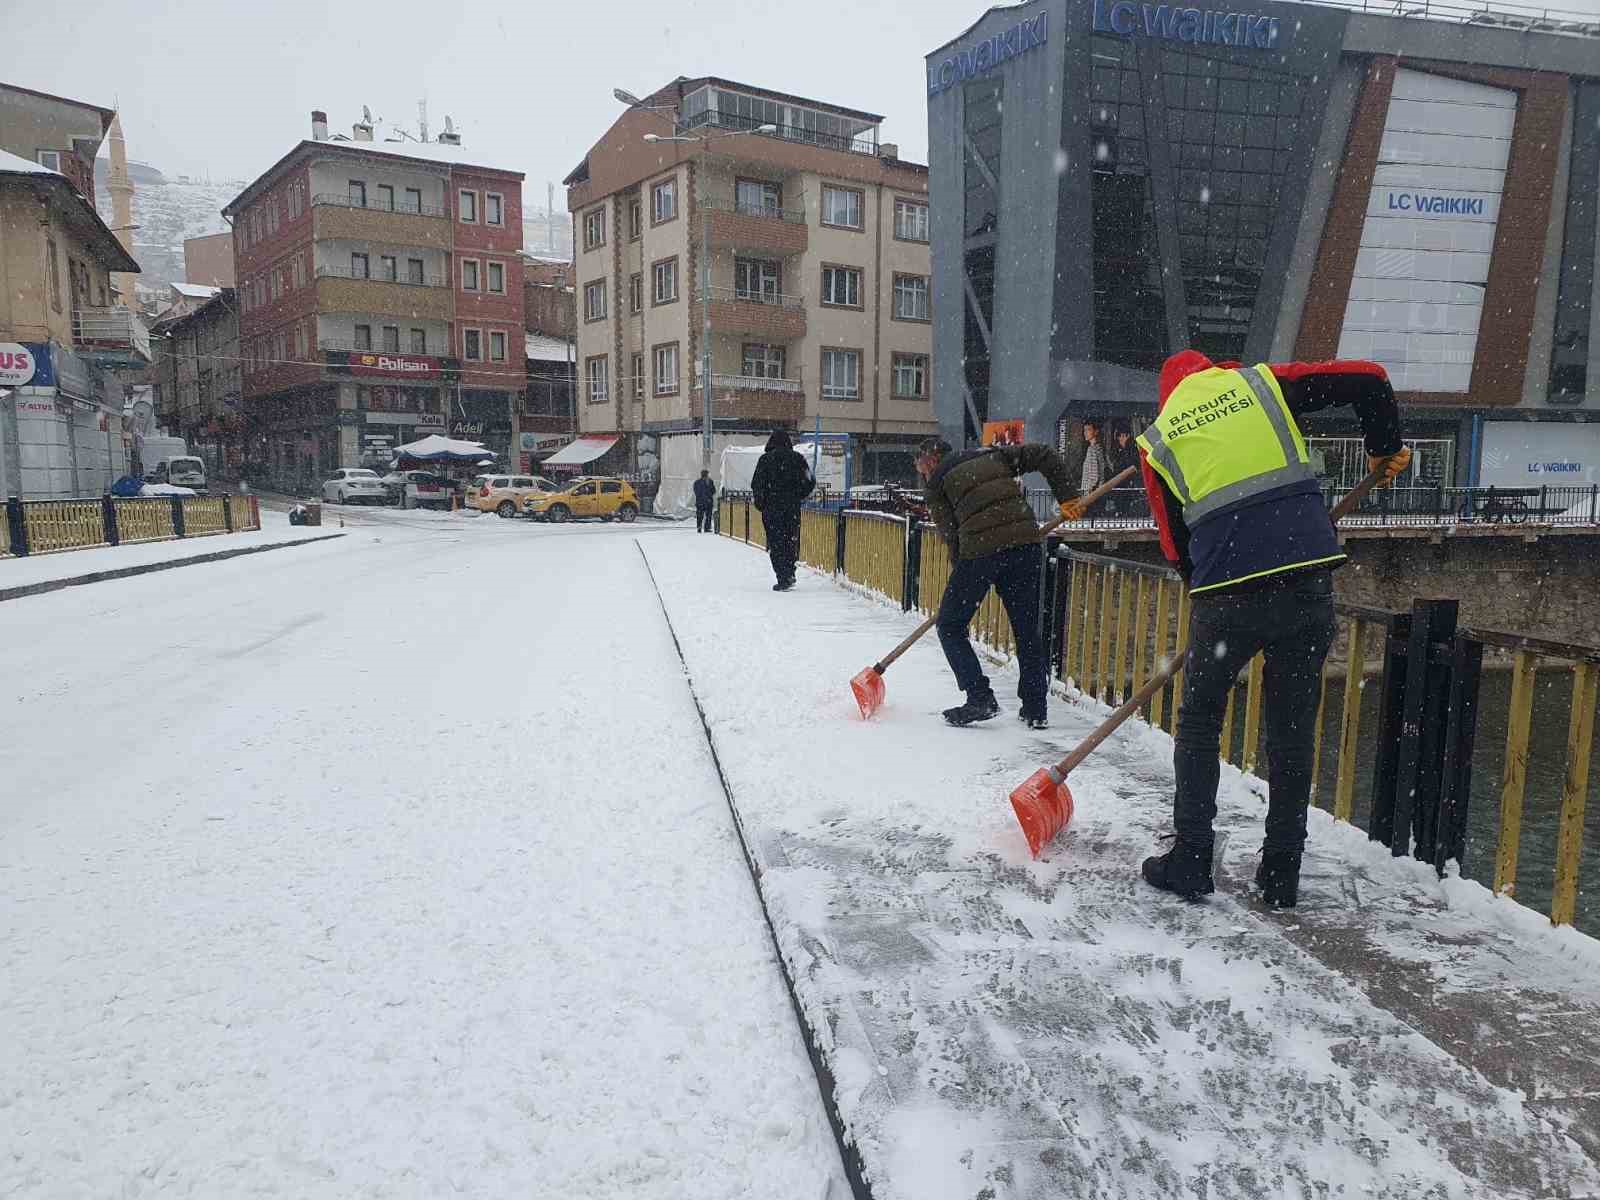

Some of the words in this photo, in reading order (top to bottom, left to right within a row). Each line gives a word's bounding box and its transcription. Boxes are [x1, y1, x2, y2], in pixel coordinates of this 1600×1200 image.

[1388, 193, 1411, 210] LC
[378, 356, 429, 371] Polisan
[1169, 388, 1239, 426] BAYBURT
[1167, 394, 1255, 440] BELEDİYESİ
[1528, 463, 1540, 472] LC
